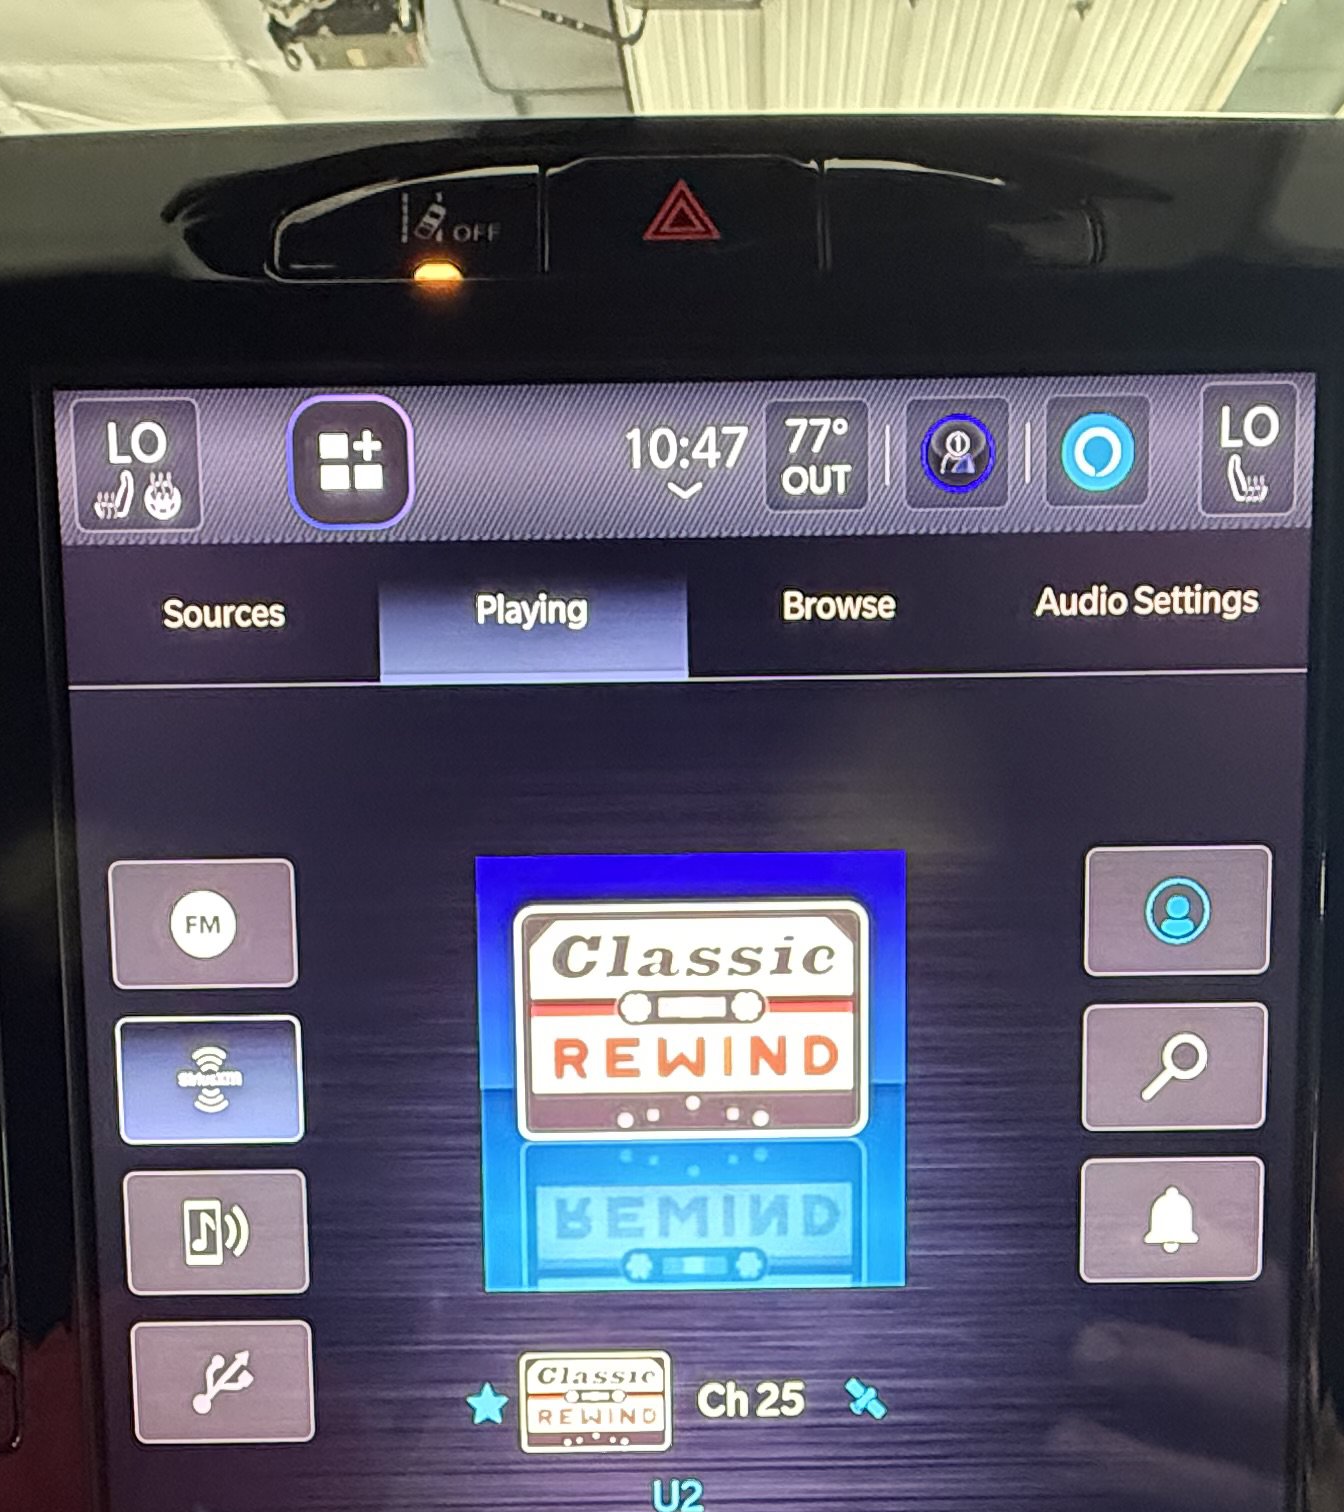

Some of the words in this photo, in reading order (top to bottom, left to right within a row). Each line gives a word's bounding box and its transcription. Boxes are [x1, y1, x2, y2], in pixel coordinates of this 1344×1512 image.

[453, 222, 502, 242] OFF
[107, 420, 168, 465] LO
[1219, 404, 1280, 449] LO
[625, 424, 749, 471] 10:47
[781, 464, 852, 497] OUT
[162, 598, 287, 630] Sources
[476, 592, 588, 632] Playing
[782, 589, 897, 622] Browse
[1035, 584, 1128, 618] Audio
[1133, 582, 1260, 621] Settings
[185, 915, 222, 935] FM
[551, 934, 837, 979] Classic
[553, 1034, 840, 1079] REWIND
[537, 1367, 656, 1385] Classic
[538, 1407, 657, 1425] REWIND
[696, 1380, 749, 1418] Ch
[755, 1381, 806, 1418] 25
